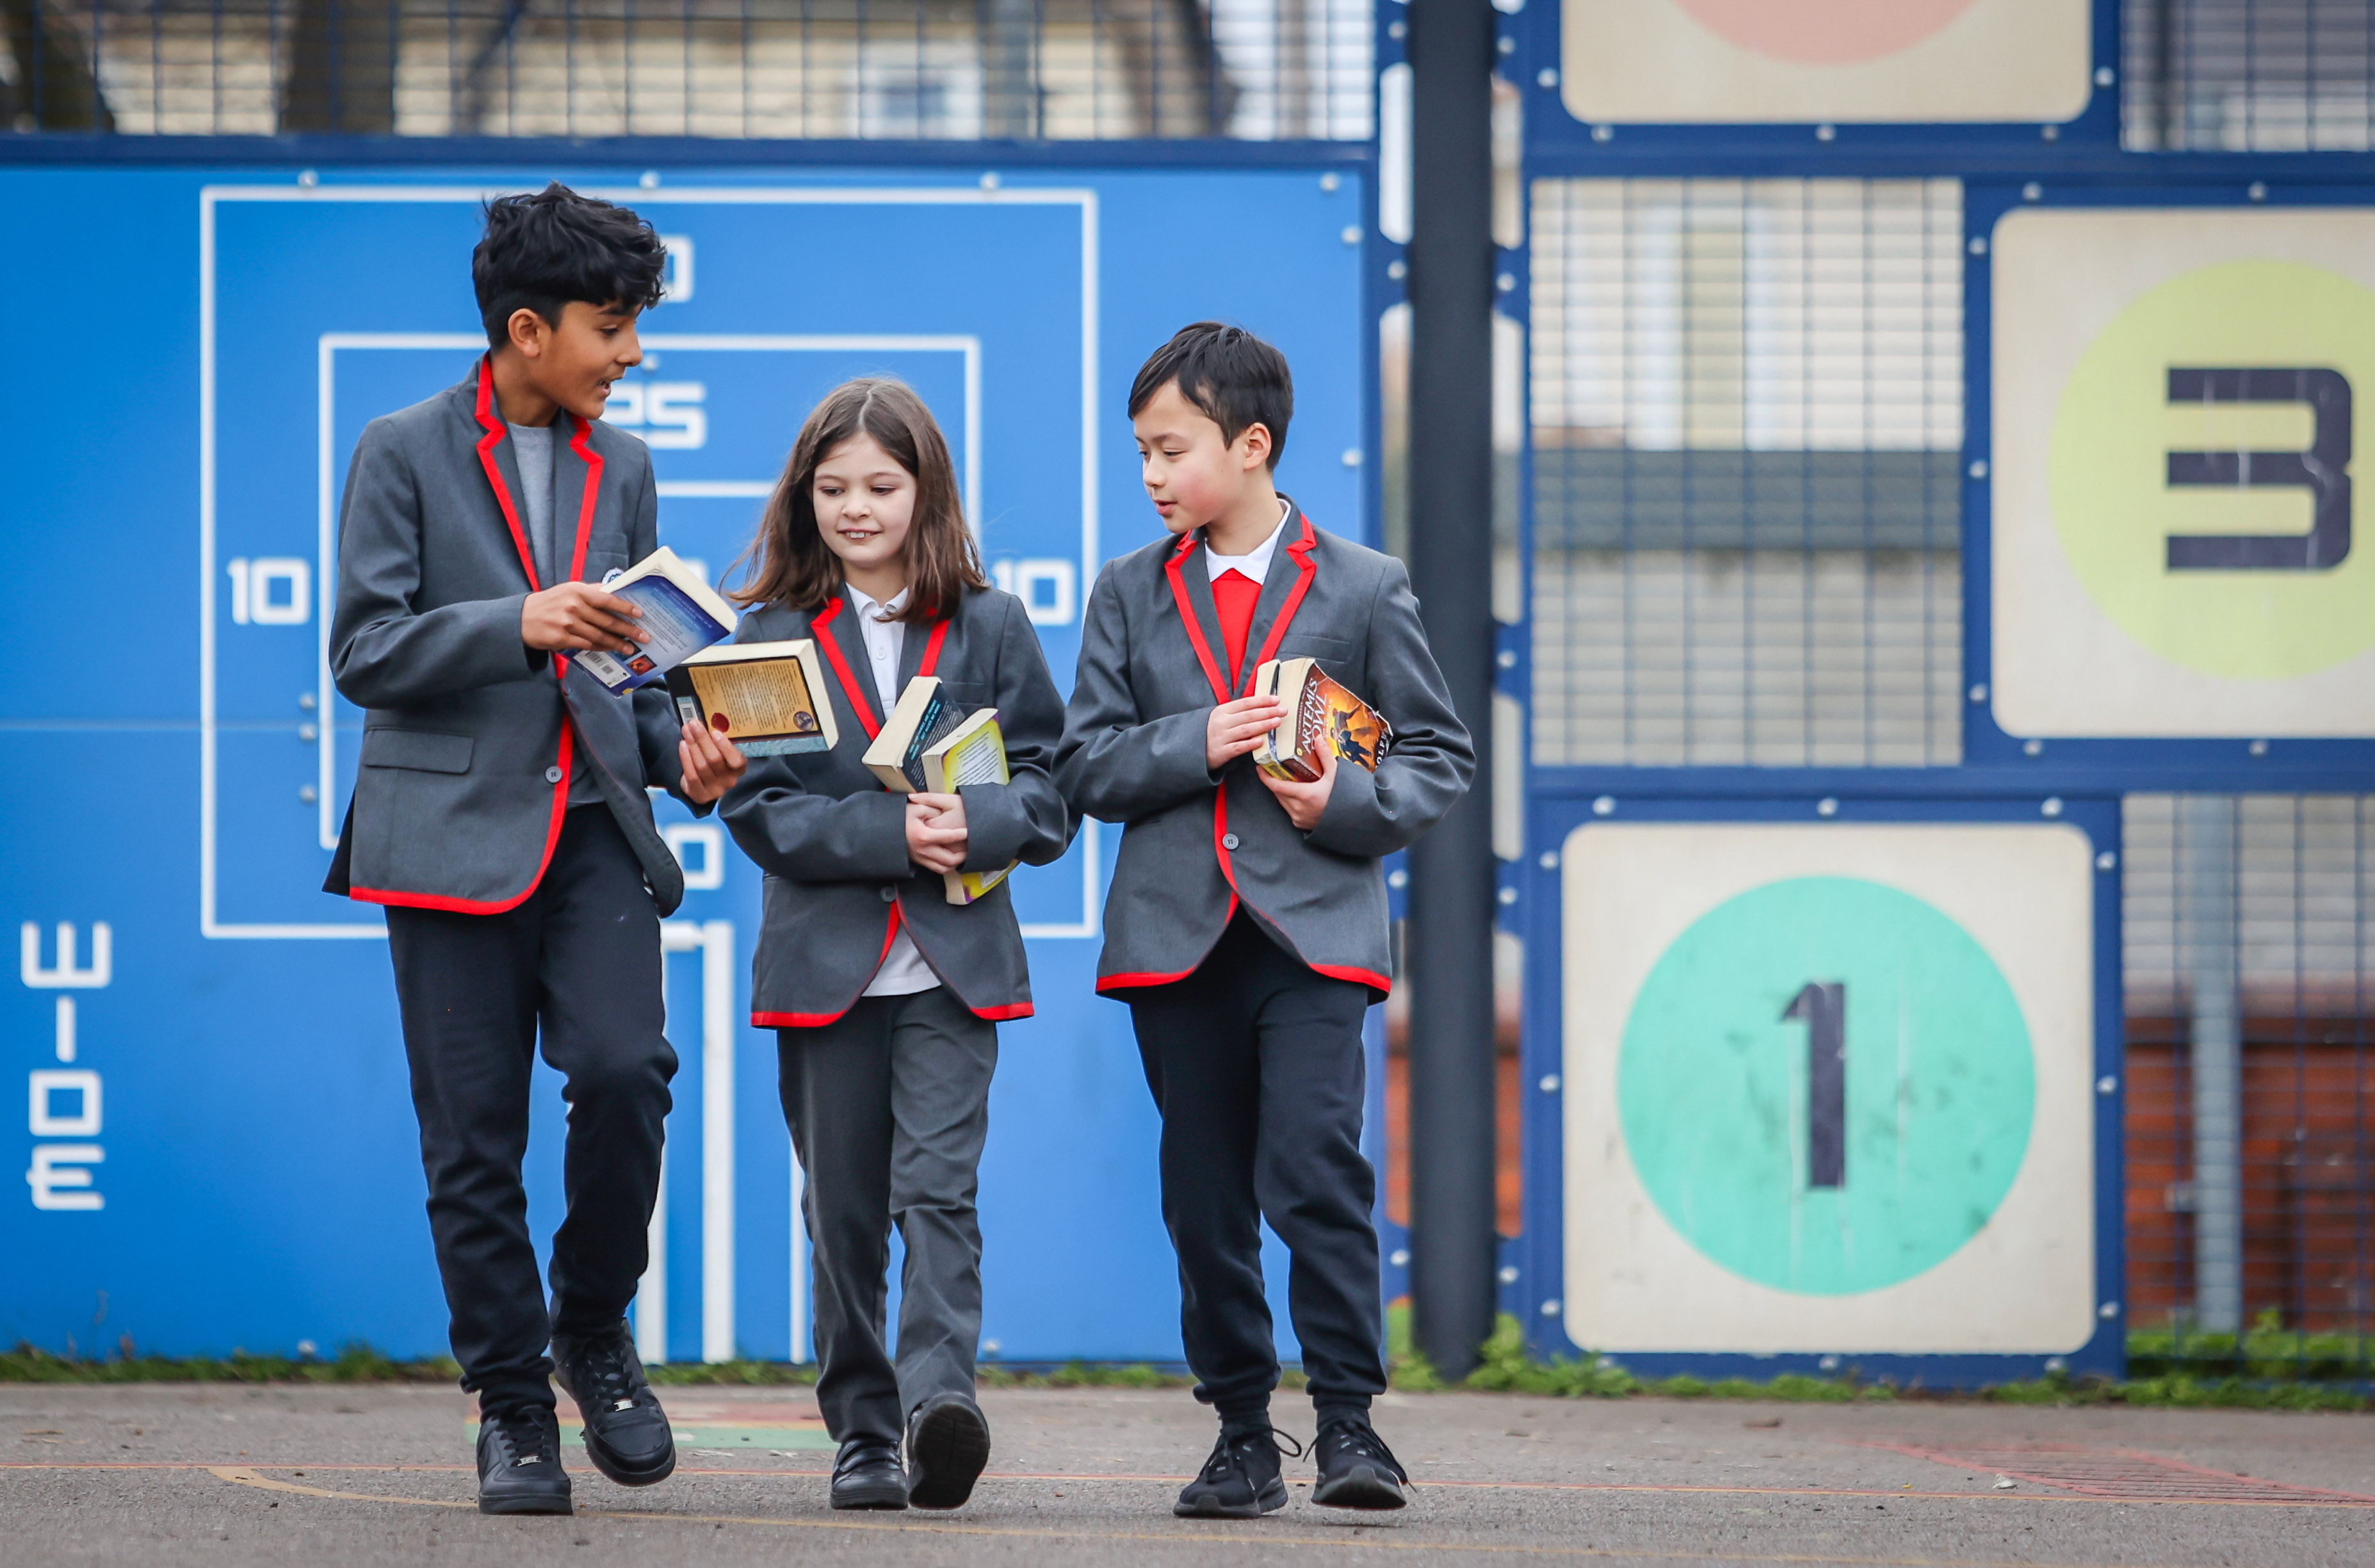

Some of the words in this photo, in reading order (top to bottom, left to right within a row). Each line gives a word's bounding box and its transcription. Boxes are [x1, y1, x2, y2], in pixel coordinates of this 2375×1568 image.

[2167, 367, 2351, 569] 3
[227, 558, 311, 624] 10
[993, 558, 1074, 625] 10
[1302, 677, 1317, 755] ARTEMIS
[1375, 727, 1389, 768] OLFER
[656, 824, 724, 889] 0
[20, 921, 112, 1211] WIDE
[1780, 981, 1846, 1191] 1
